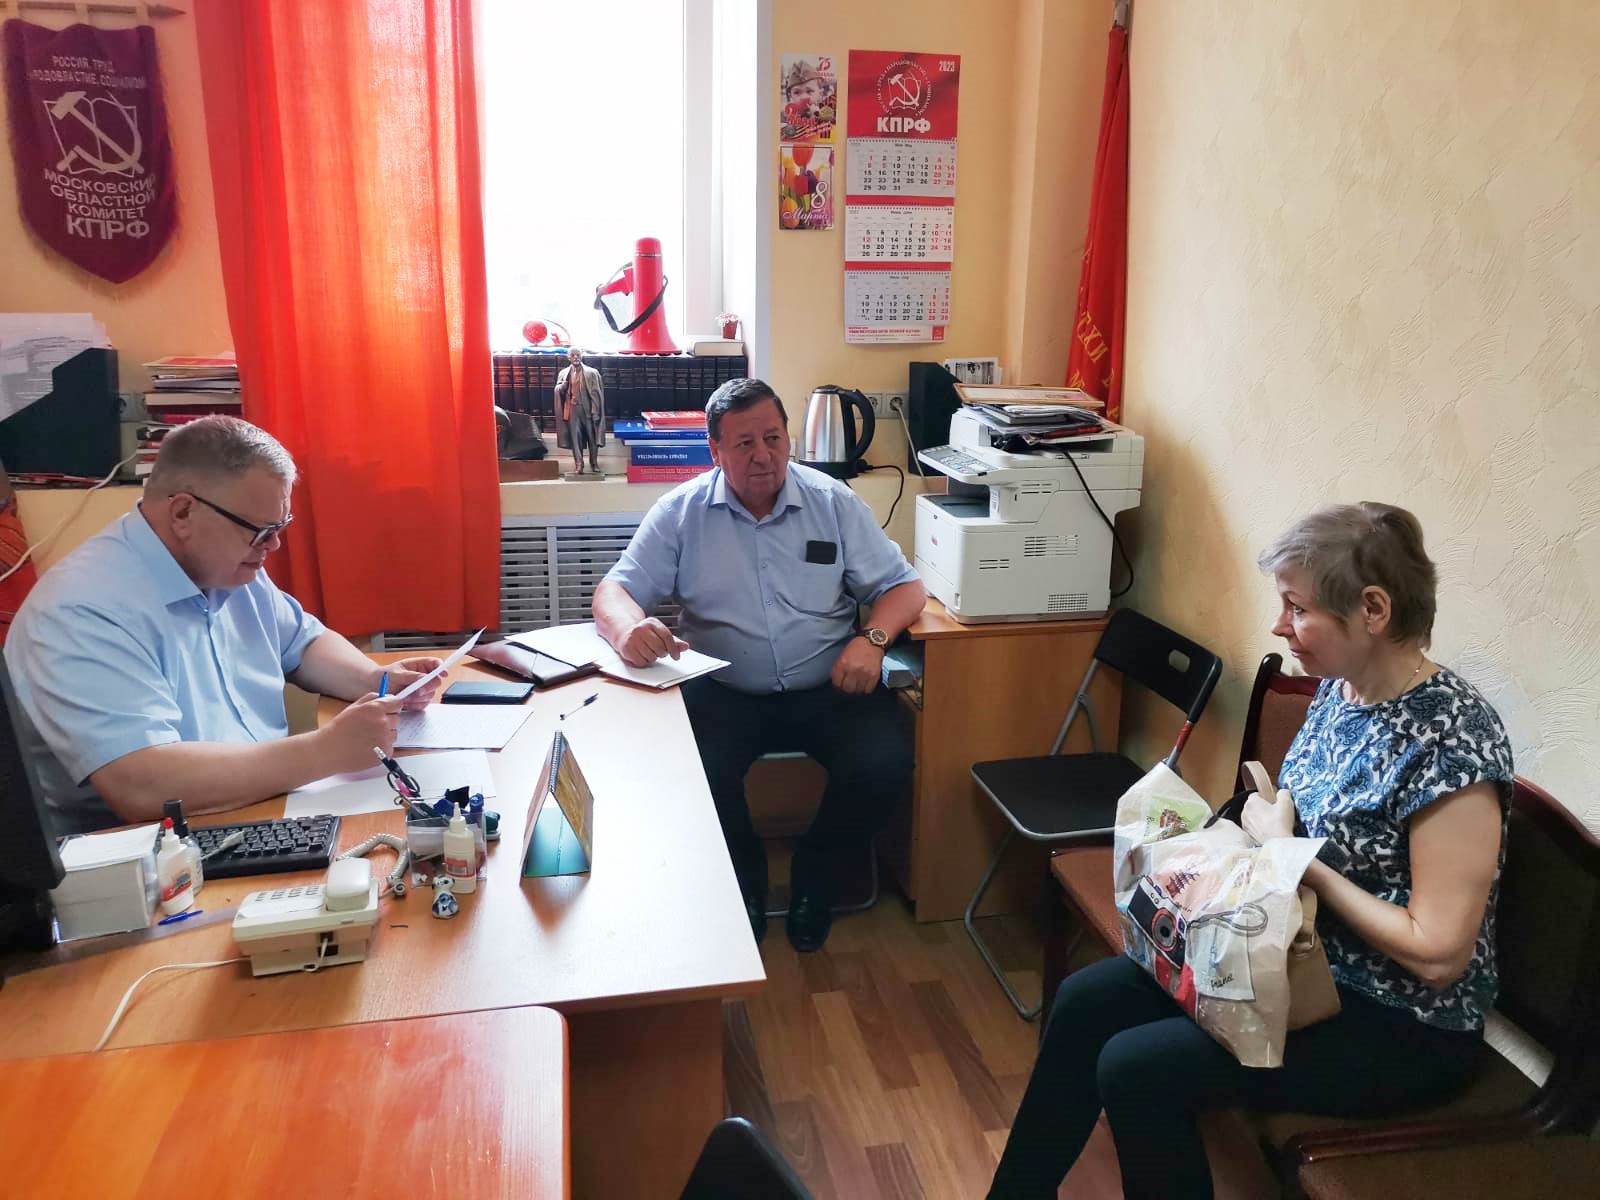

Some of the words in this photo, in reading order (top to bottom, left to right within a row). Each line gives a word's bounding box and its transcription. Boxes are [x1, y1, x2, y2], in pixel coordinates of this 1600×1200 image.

[939, 60, 956, 72] 2023
[877, 117, 931, 134] КПРФ
[811, 181, 828, 208] 8
[68, 202, 146, 219] КОМИТЕТ
[66, 214, 150, 240] КПРФ
